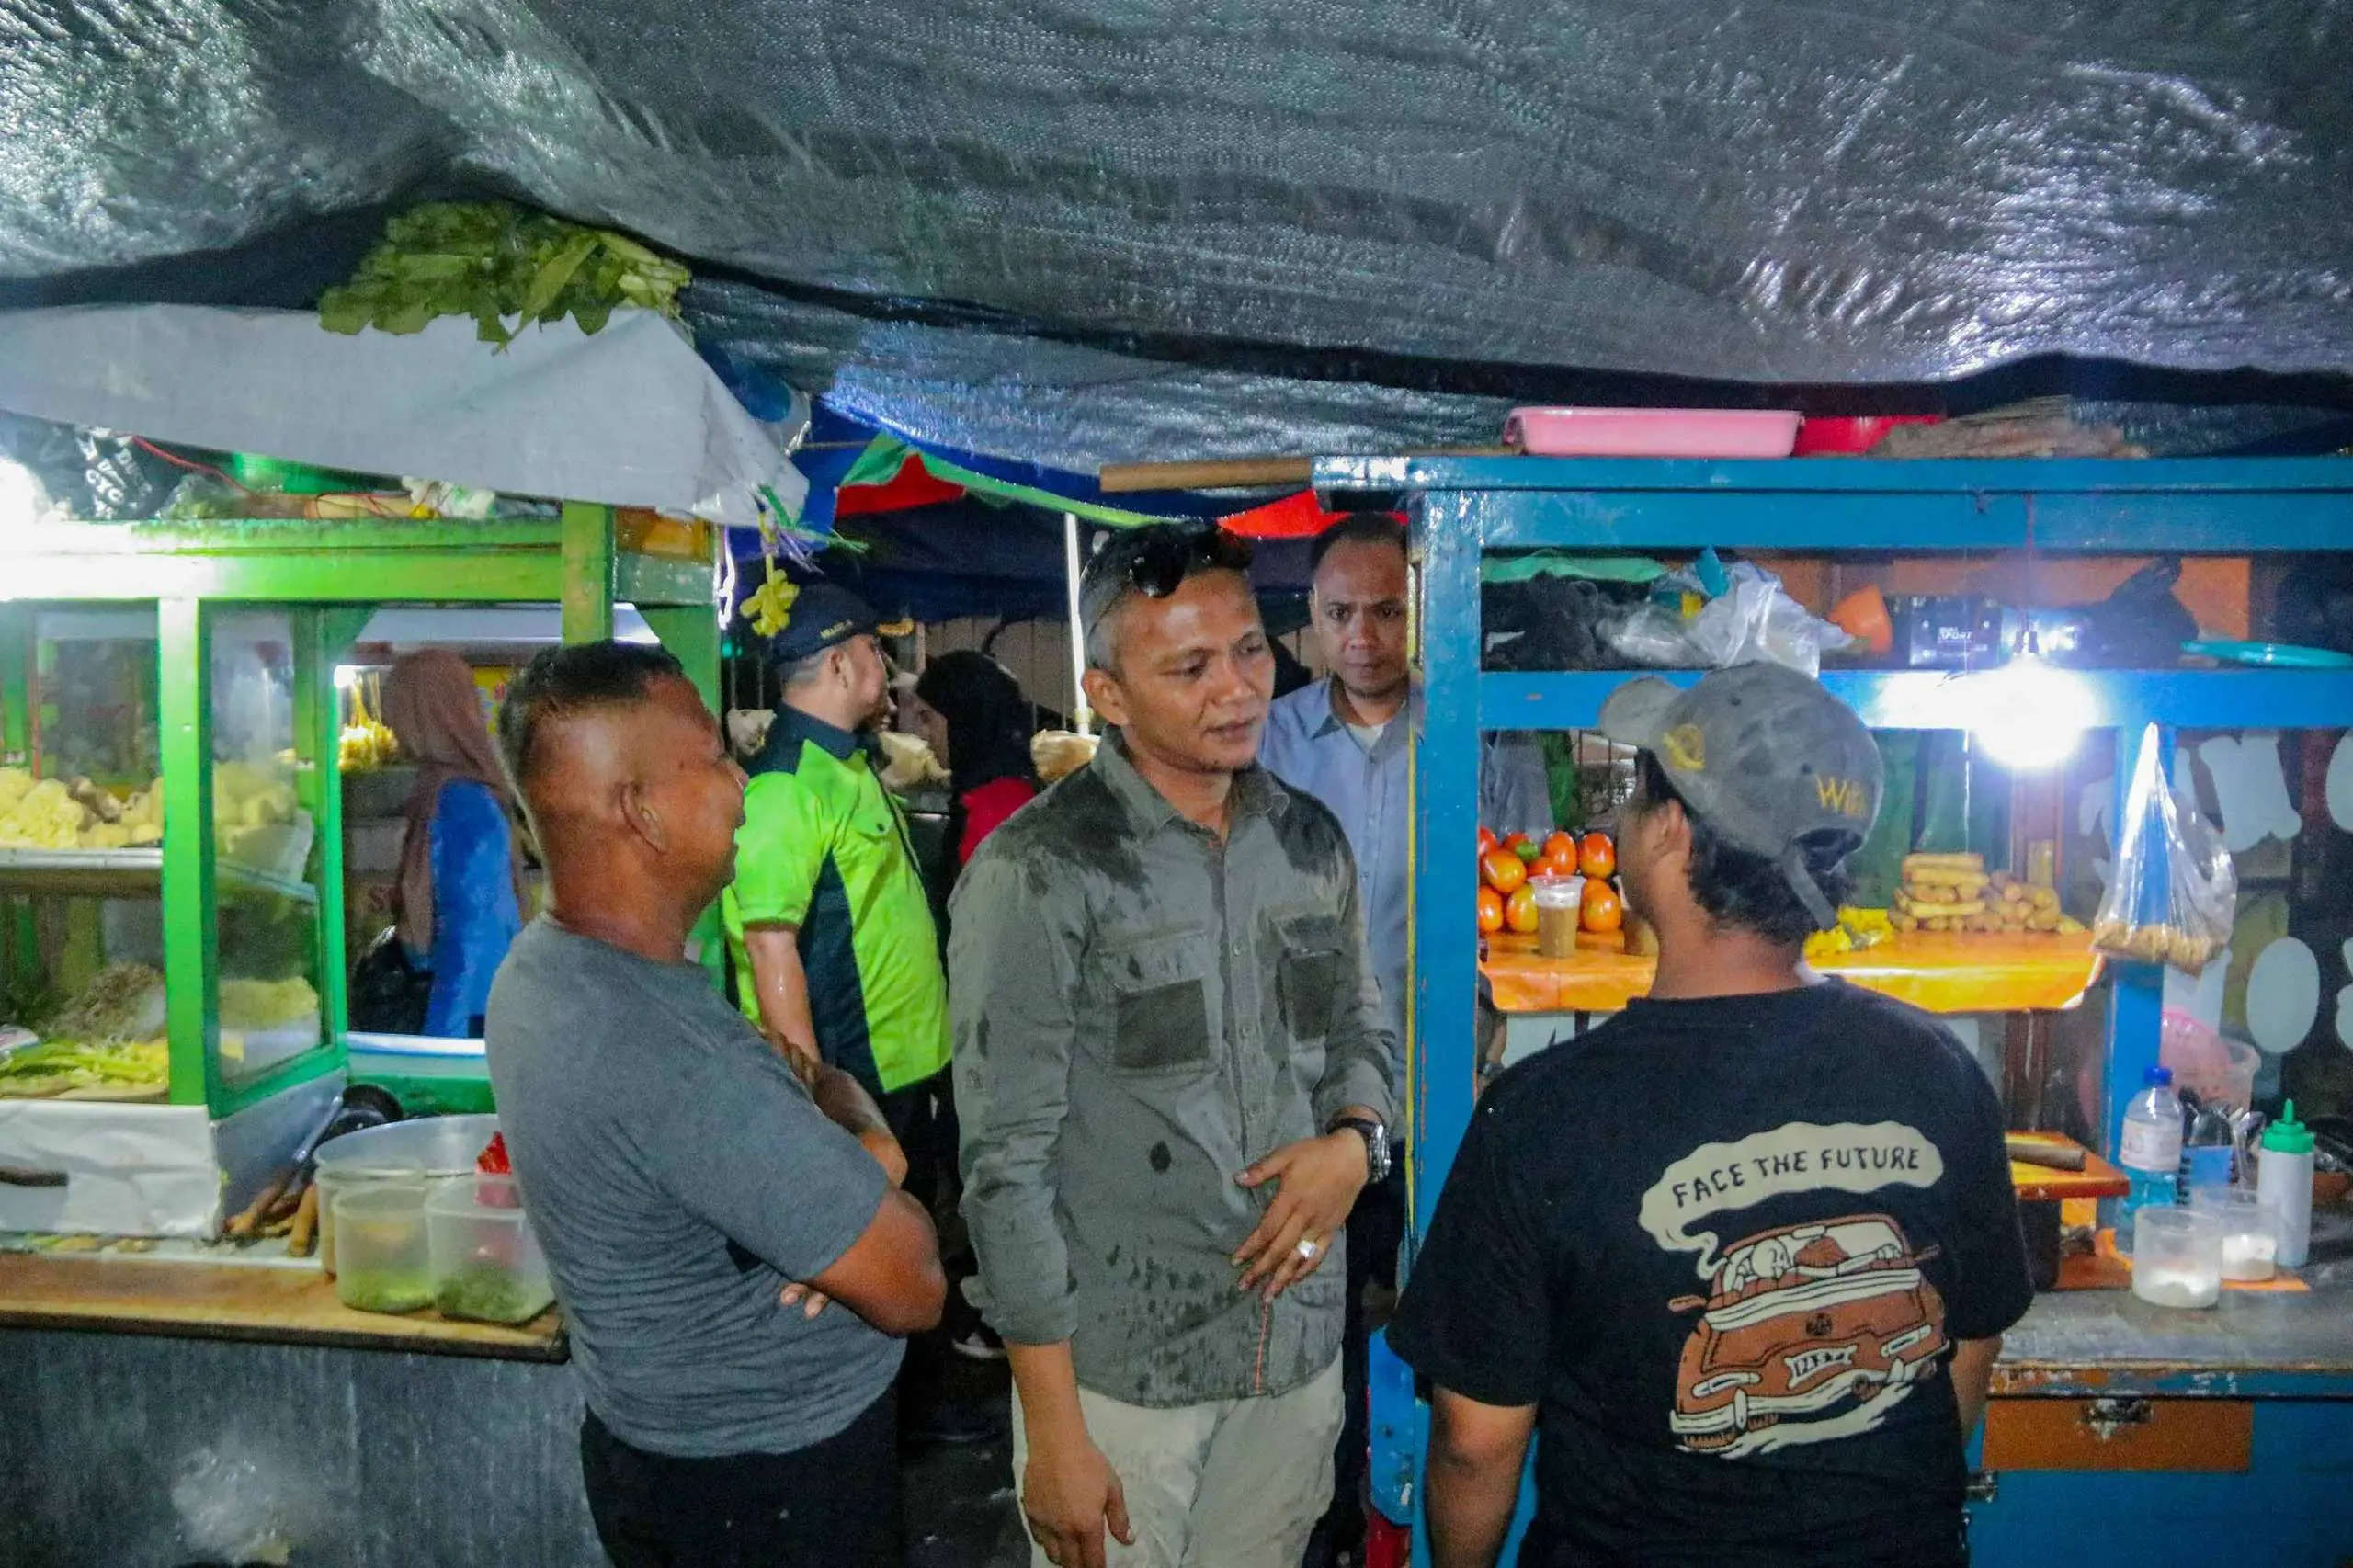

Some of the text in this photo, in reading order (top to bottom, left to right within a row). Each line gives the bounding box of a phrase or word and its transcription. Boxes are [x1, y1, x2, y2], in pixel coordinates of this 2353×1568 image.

[1672, 1146, 1920, 1208] FACE THE FUTURE
